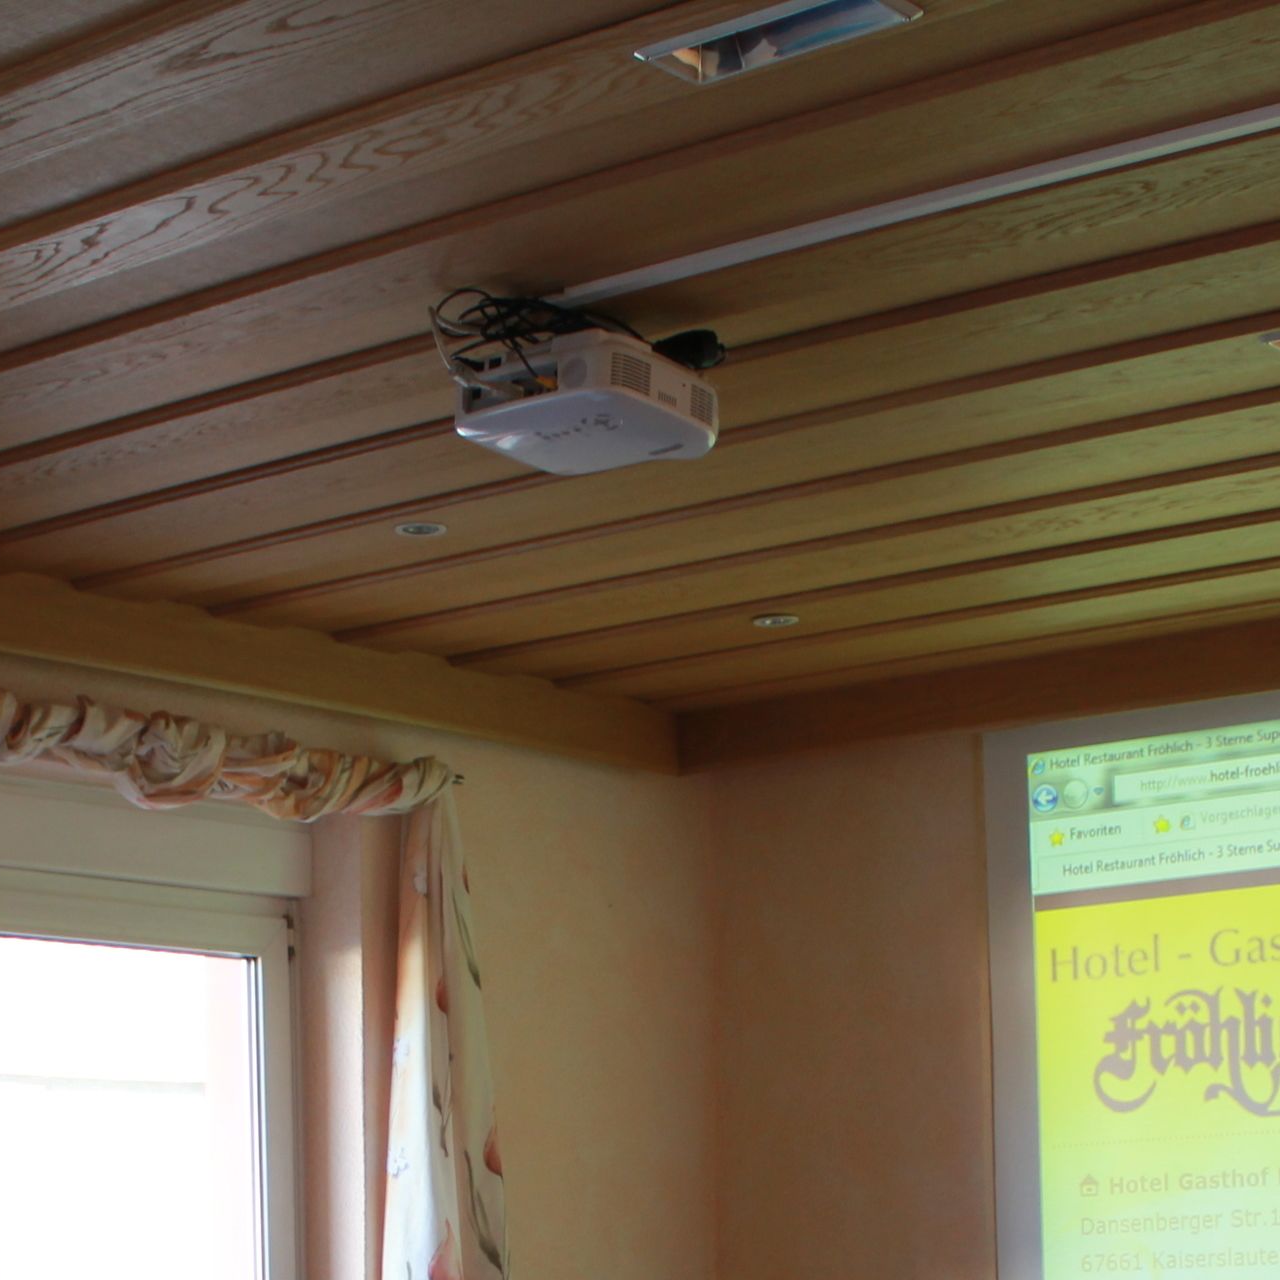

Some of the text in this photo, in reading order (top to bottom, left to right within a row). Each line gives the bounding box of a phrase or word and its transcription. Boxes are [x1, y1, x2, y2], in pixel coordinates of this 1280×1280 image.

[1049, 753, 1081, 770] Hotel
[1084, 742, 1144, 766] Restaurant
[1147, 738, 1194, 759] Fröhlich
[1205, 736, 1213, 748] 3
[1216, 732, 1254, 748] Sterne
[1070, 822, 1122, 841] Favoriten
[1063, 860, 1093, 878] Hotel
[1096, 853, 1156, 874] Restaurant
[1159, 846, 1205, 866] Fröhlich
[1217, 846, 1224, 858] 3
[1227, 842, 1264, 857] Sterne
[1050, 934, 1160, 982] Hotel
[1109, 1173, 1170, 1196] Hotel
[1178, 1167, 1270, 1191] Gasthof
[1080, 1212, 1222, 1237] Dansenberger
[1080, 1252, 1144, 1273] 67661
